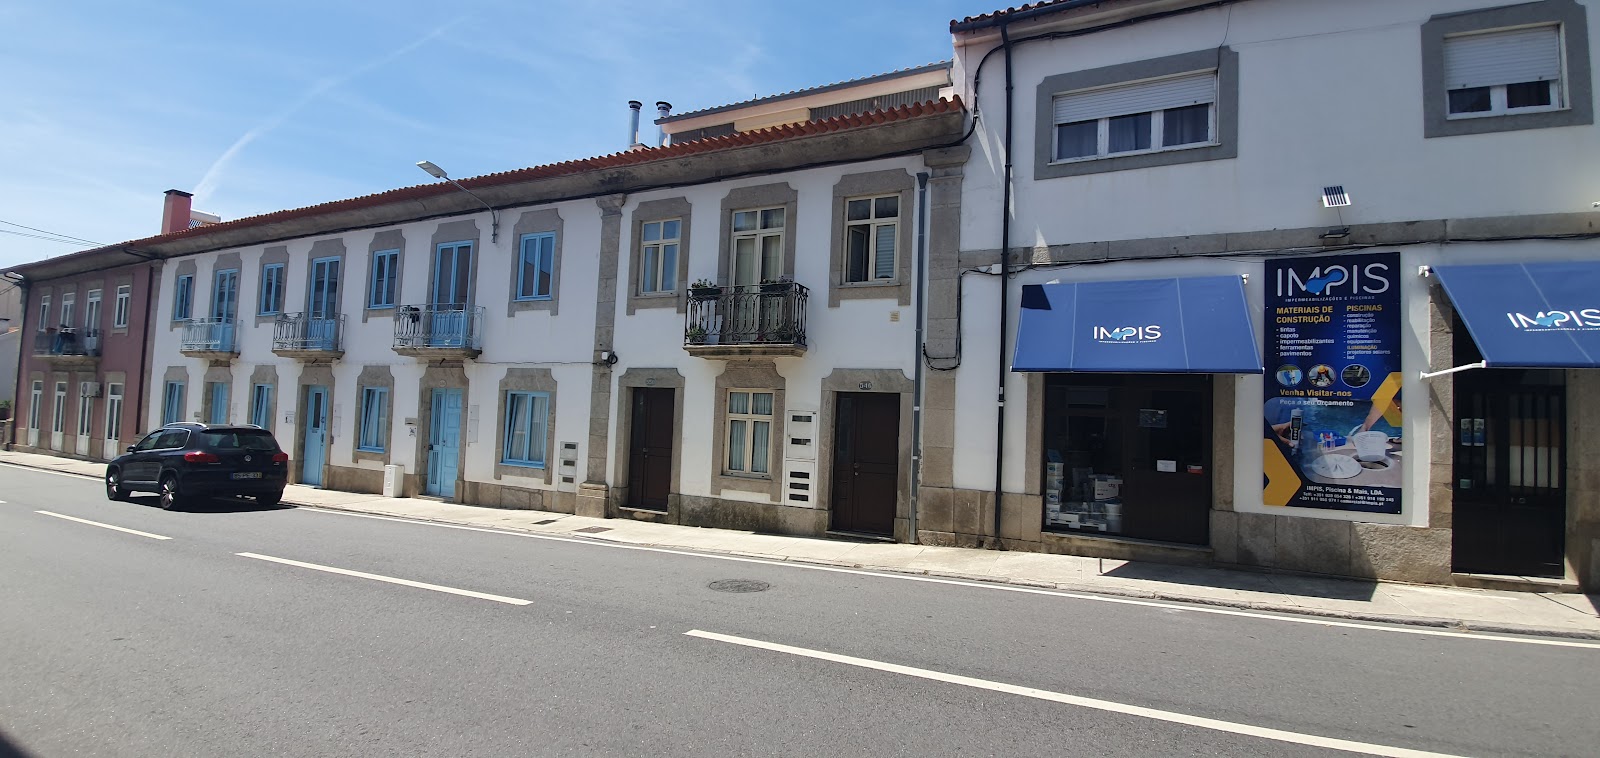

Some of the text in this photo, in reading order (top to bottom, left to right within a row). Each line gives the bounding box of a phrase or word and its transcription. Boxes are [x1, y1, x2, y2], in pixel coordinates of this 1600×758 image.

[1277, 262, 1390, 296] IMPIS
[1276, 314, 1330, 324] CONSTRUÇÃO
[1094, 325, 1161, 340] IMPIS
